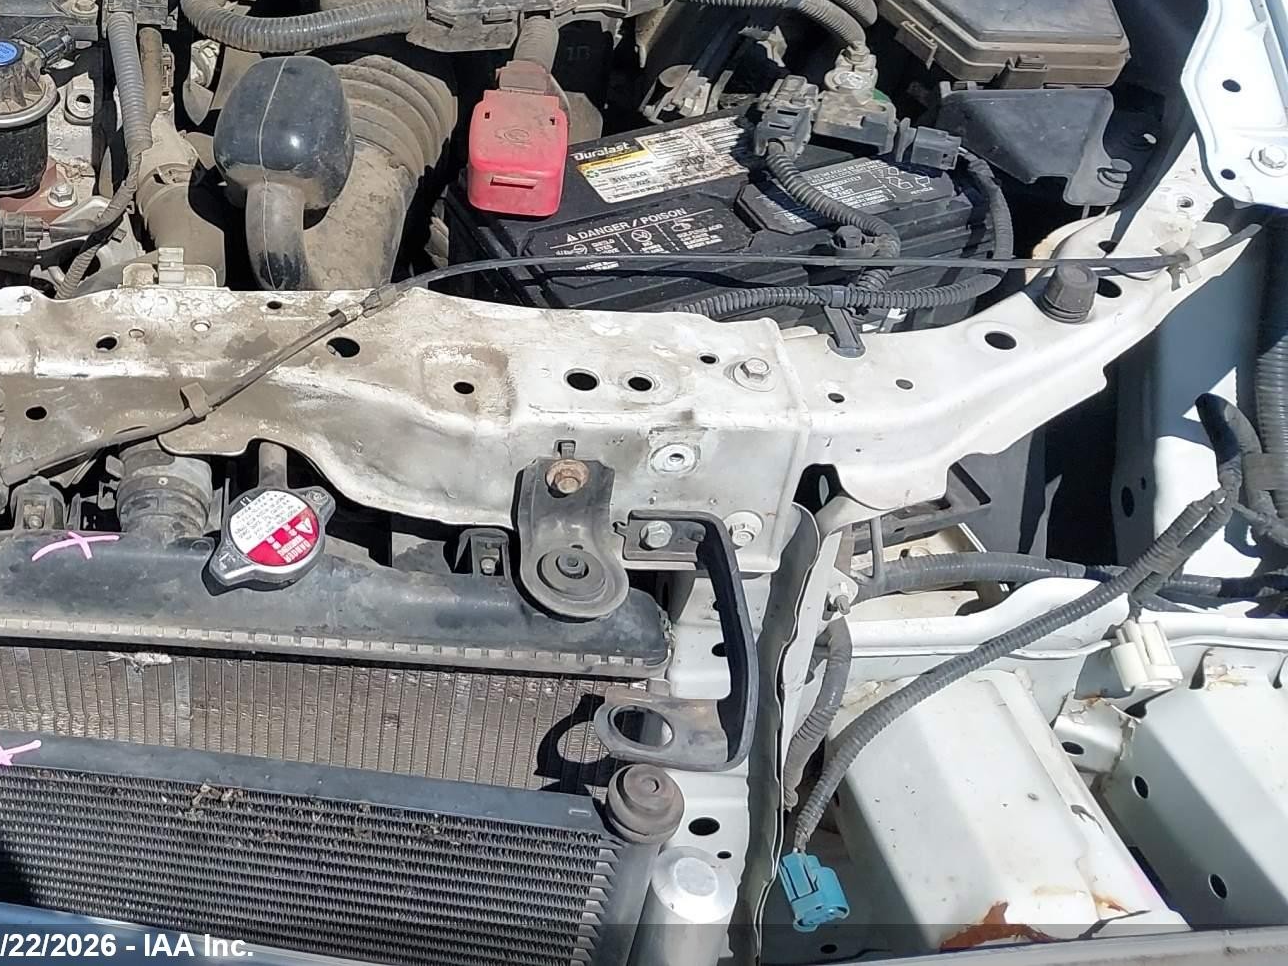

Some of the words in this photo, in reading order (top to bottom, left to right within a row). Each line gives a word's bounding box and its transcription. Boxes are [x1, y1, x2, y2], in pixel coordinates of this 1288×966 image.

[570, 141, 632, 161] Duralast
[578, 221, 630, 240] DANGER
[641, 207, 687, 225] POISON
[283, 539, 312, 563] DANGER
